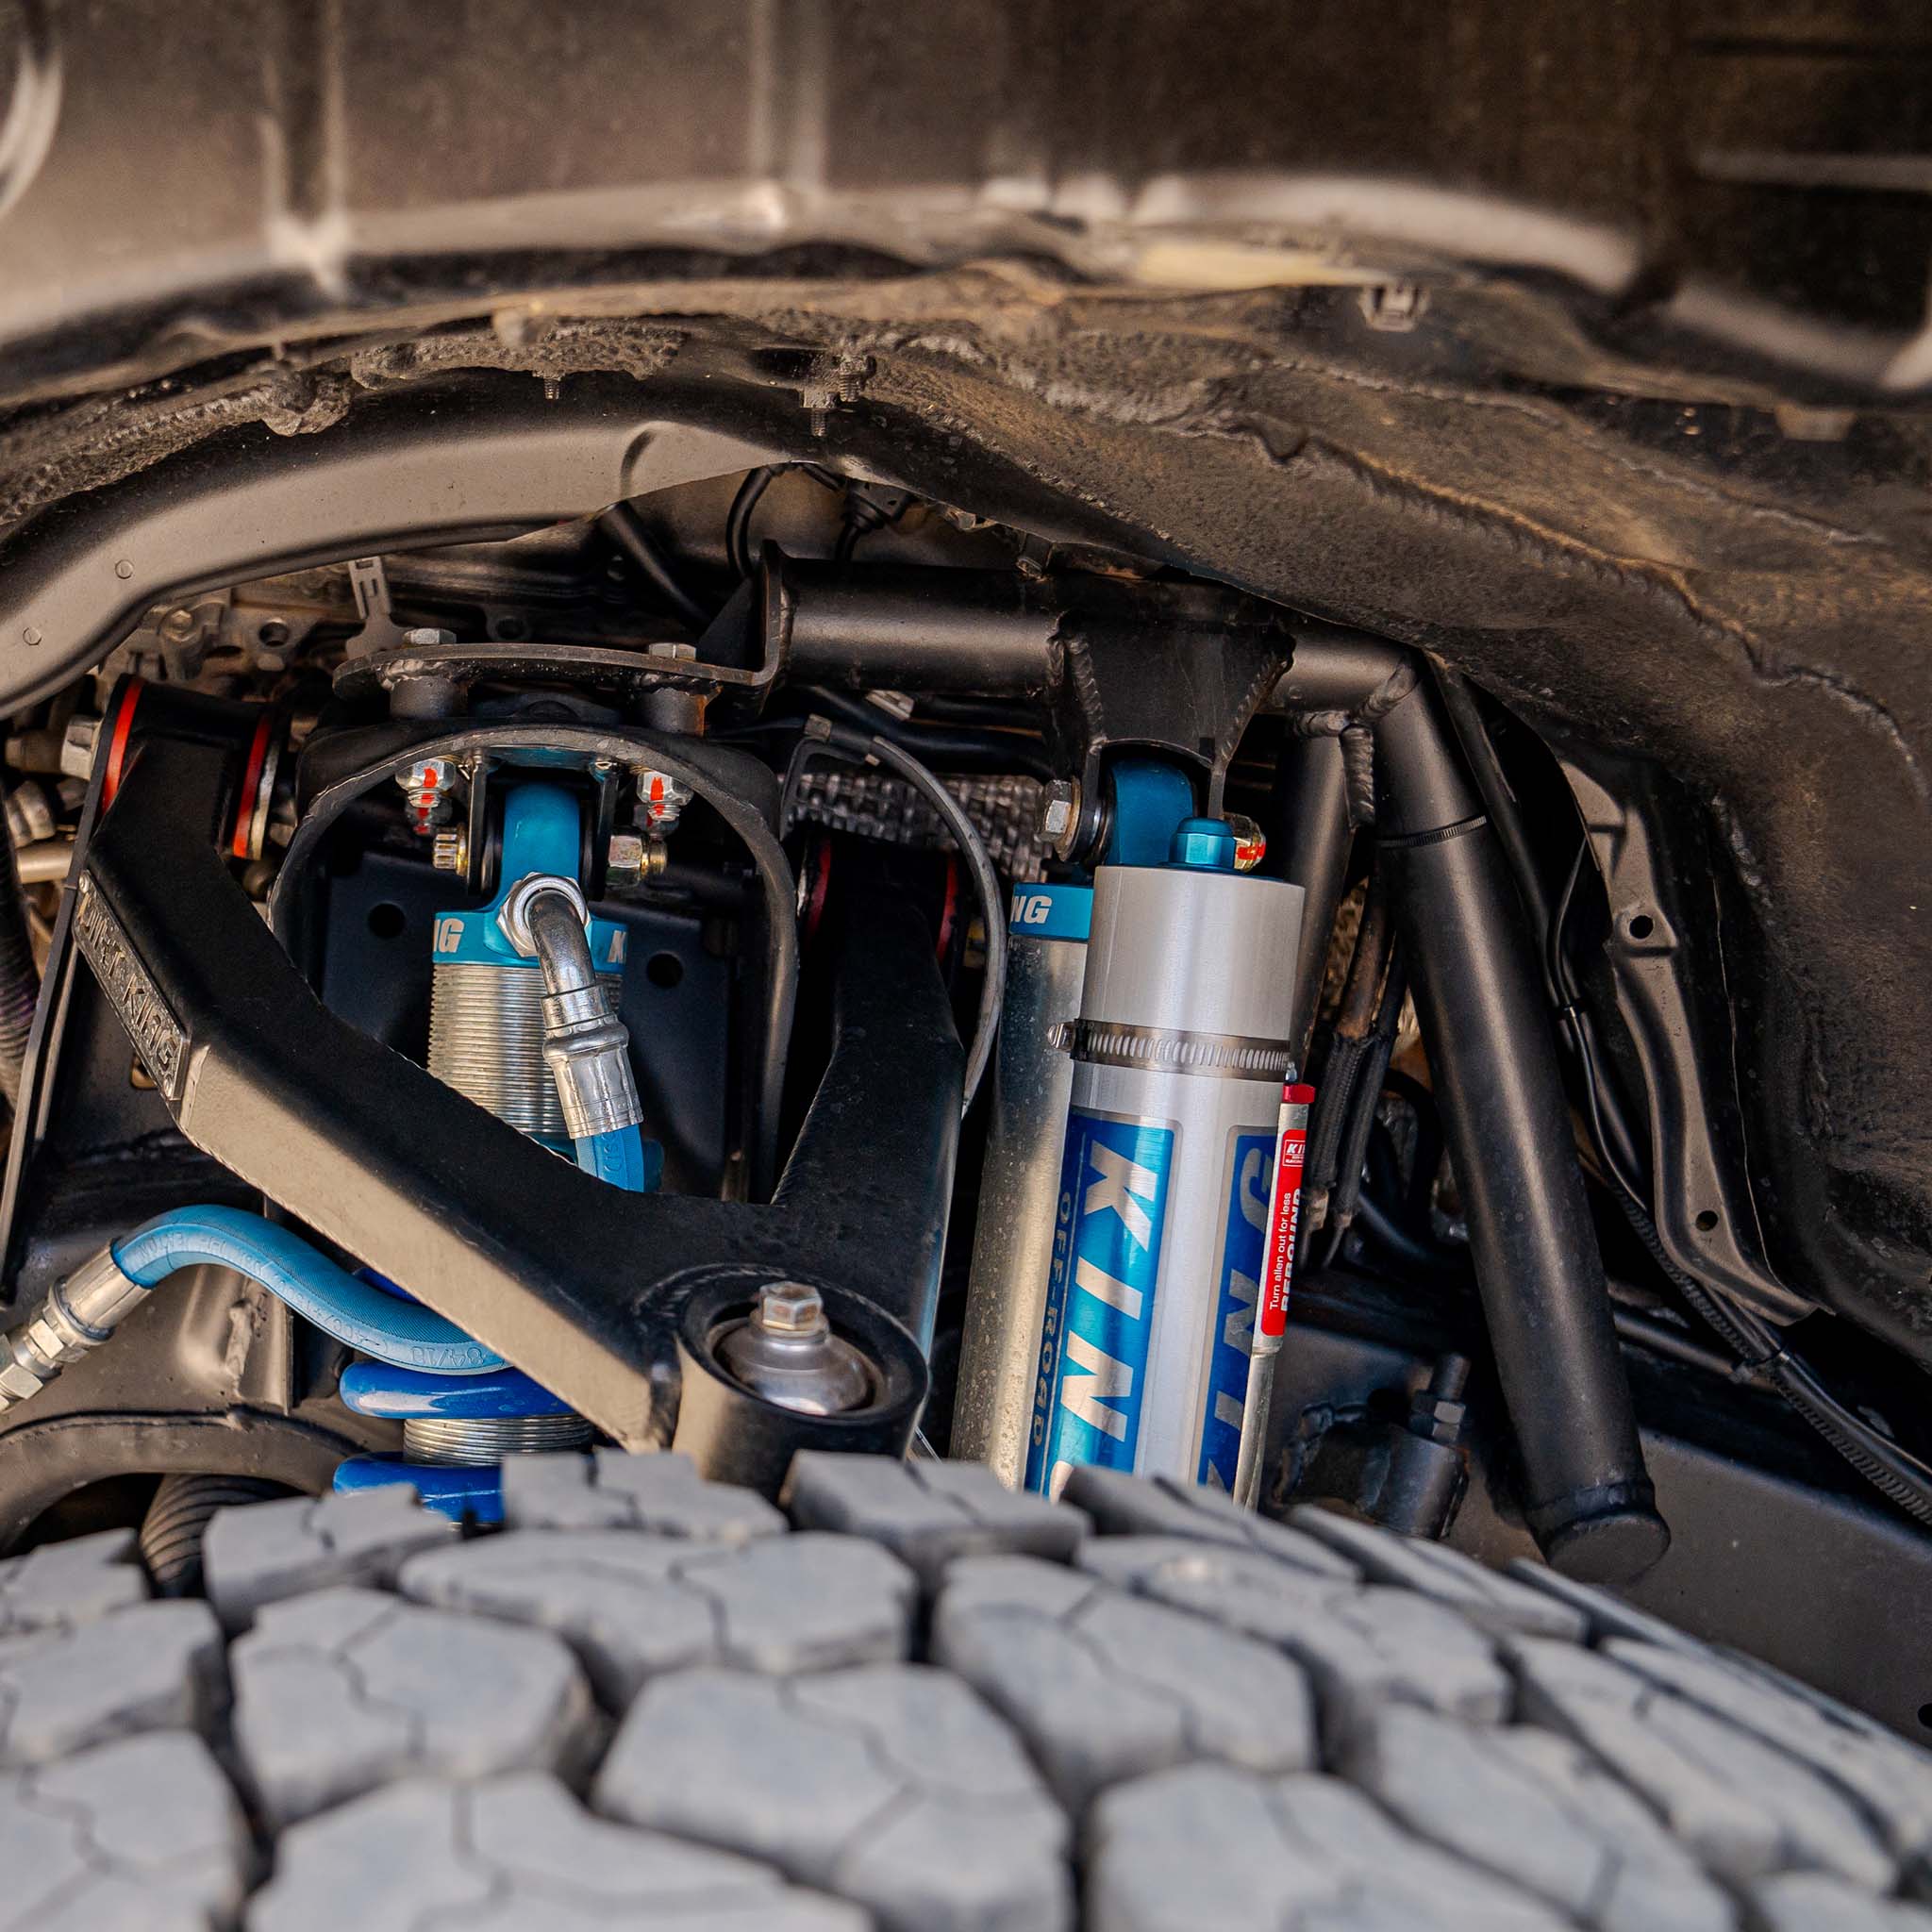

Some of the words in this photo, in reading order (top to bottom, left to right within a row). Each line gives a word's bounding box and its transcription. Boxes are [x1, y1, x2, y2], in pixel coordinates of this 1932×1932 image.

[122, 973, 178, 1072] KING
[1281, 1192, 1291, 1215] less
[1278, 1220, 1289, 1233] for
[1277, 1235, 1287, 1254] out
[1274, 1256, 1284, 1282] allen
[1269, 1285, 1281, 1310] Turn
[1049, 1140, 1158, 1506] KIN
